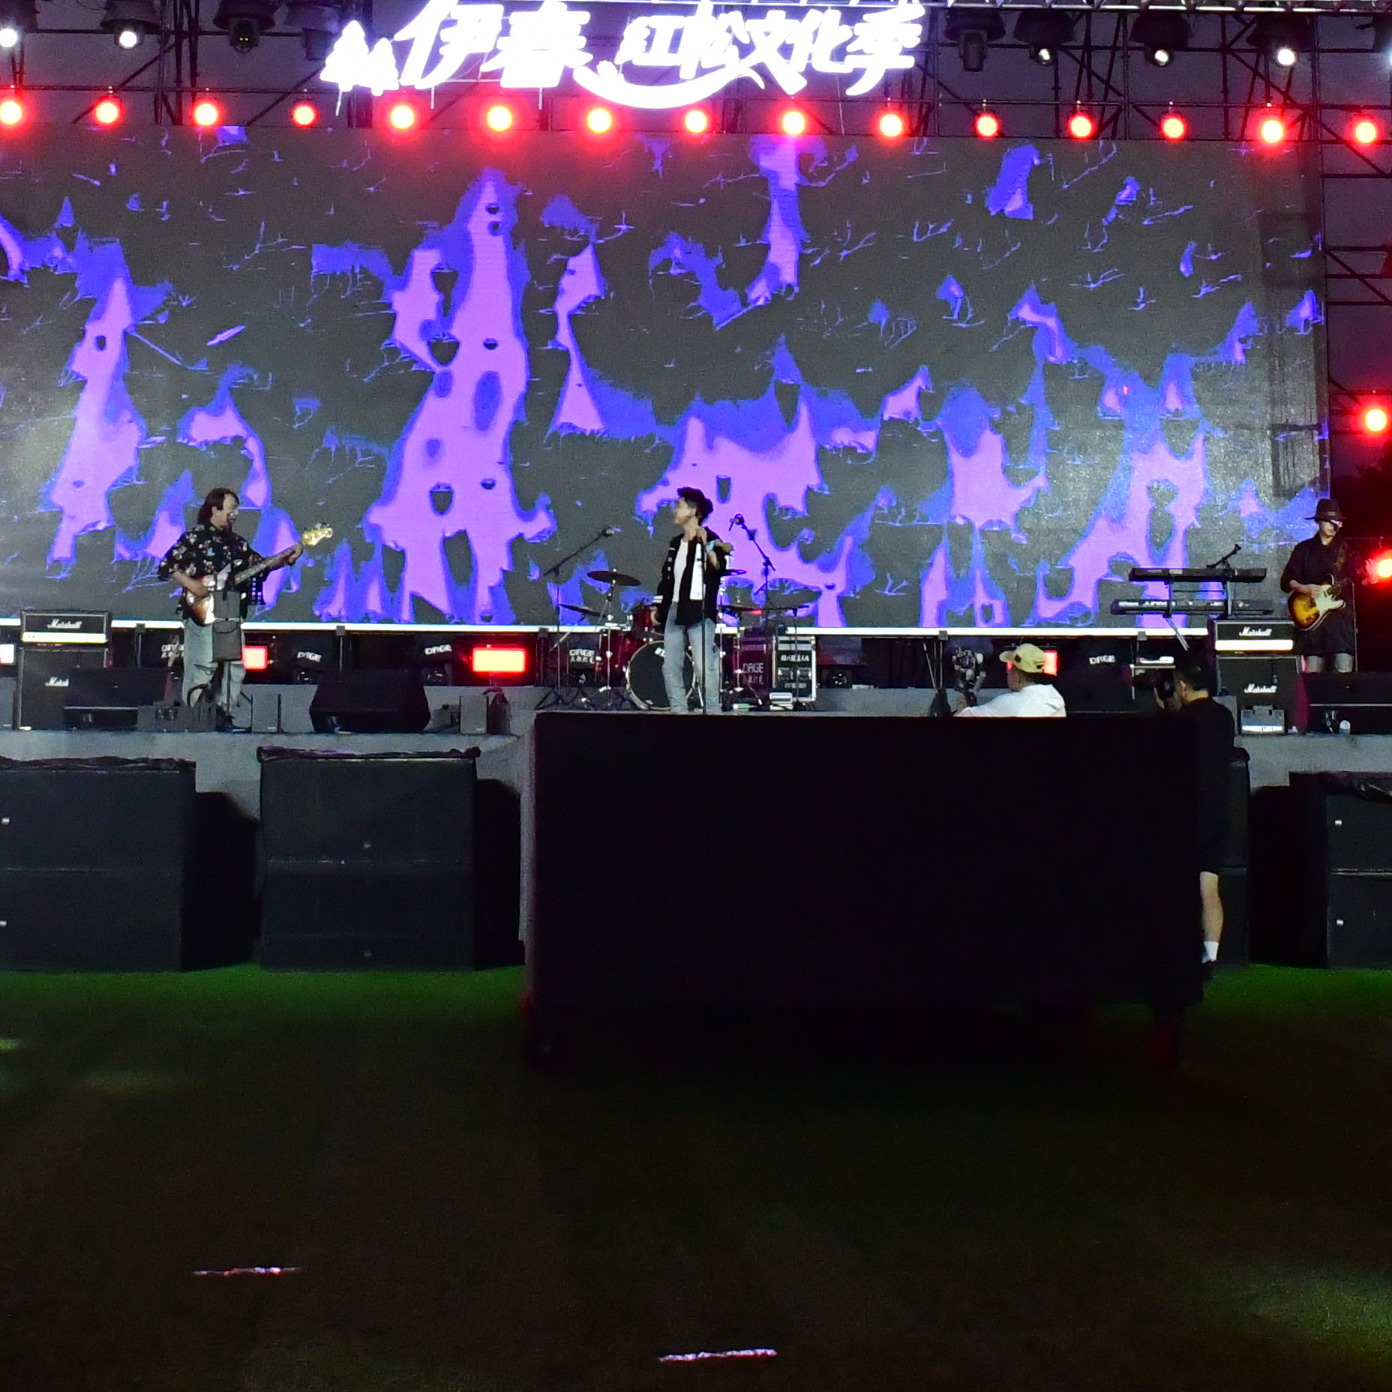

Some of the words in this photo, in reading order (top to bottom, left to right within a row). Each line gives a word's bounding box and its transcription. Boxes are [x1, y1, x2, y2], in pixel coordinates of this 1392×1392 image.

[615, 0, 925, 94] 红松文化季
[47, 618, 83, 629] Marshall
[1238, 626, 1273, 637] Marshall
